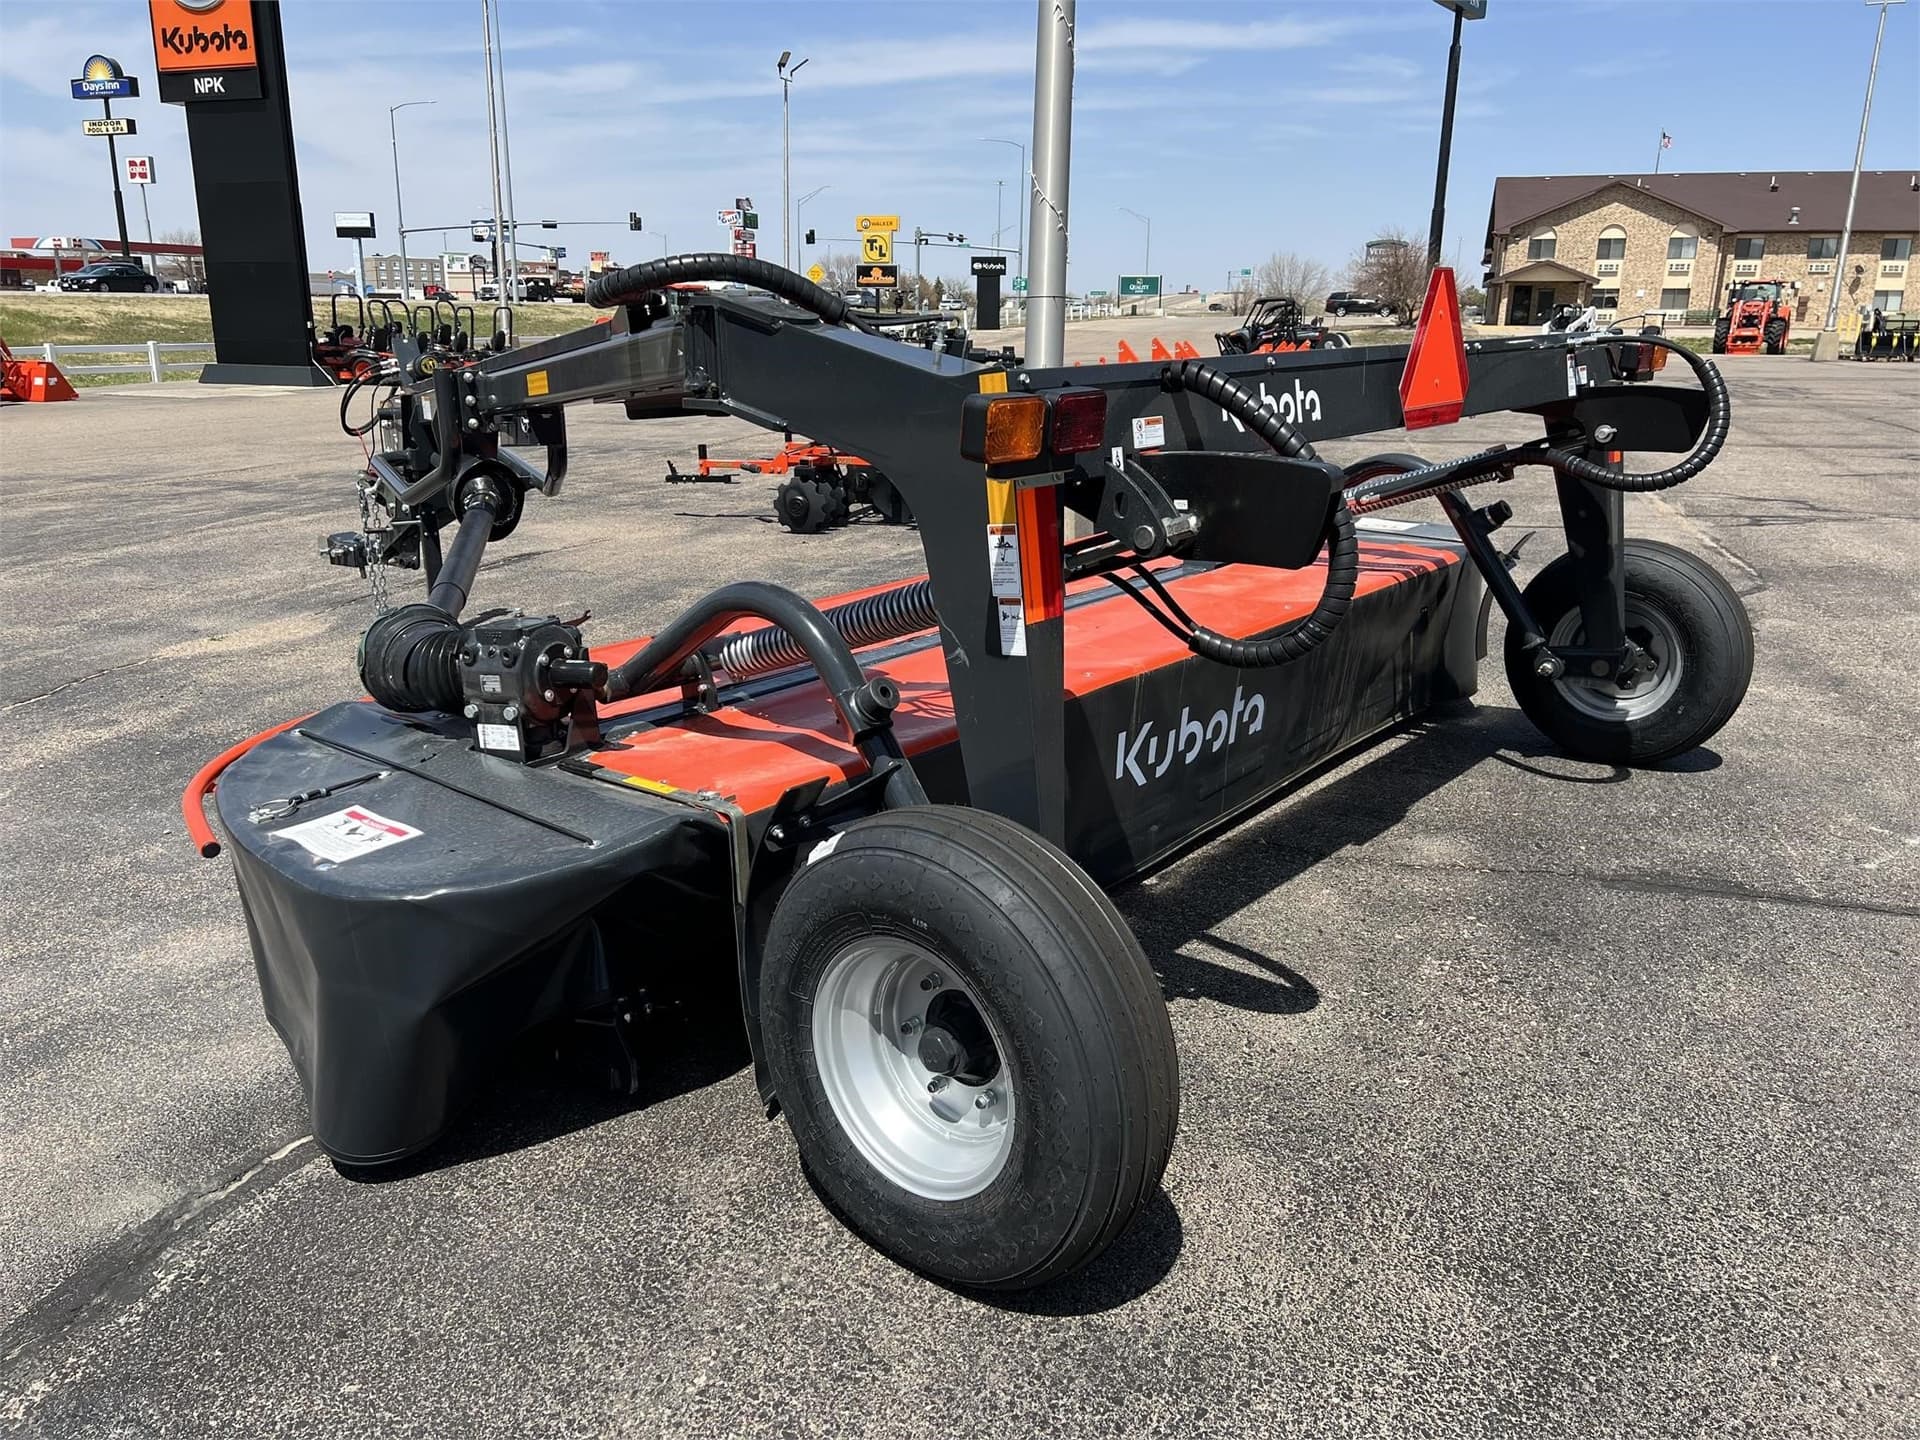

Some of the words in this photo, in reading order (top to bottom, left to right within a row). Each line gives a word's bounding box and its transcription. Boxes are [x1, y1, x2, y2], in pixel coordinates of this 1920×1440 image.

[161, 23, 247, 54] Kubota
[82, 81, 104, 91] Days
[105, 81, 120, 90] Inn
[193, 76, 226, 94] NPK
[1115, 685, 1266, 787] Kubota
